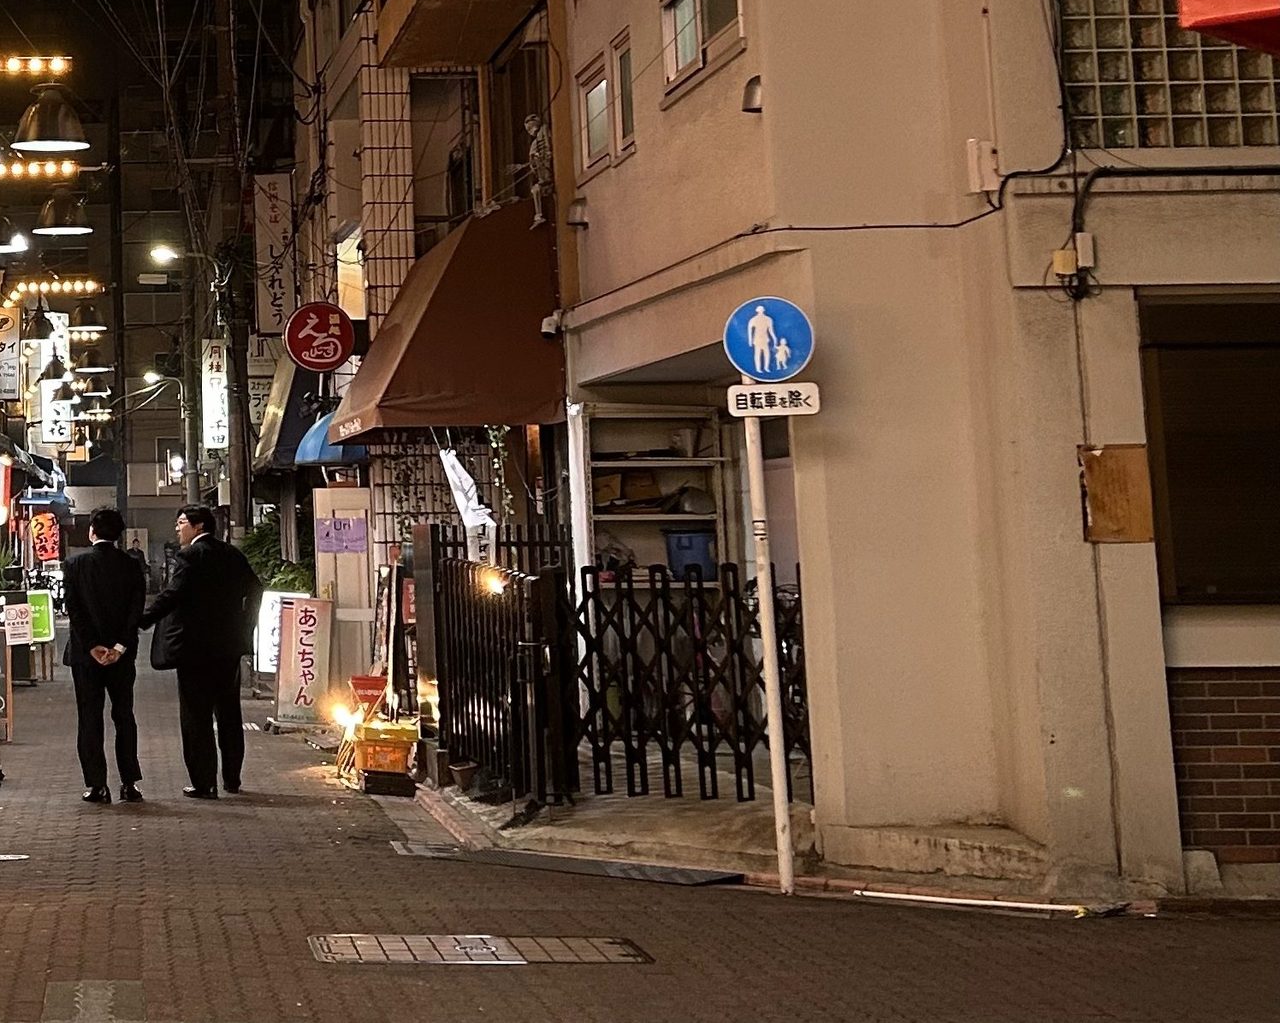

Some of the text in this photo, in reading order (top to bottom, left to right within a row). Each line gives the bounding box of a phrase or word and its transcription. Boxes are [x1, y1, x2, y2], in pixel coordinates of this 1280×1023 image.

[735, 390, 813, 410] 自転車を除く
[293, 606, 318, 707] あこちゃん
